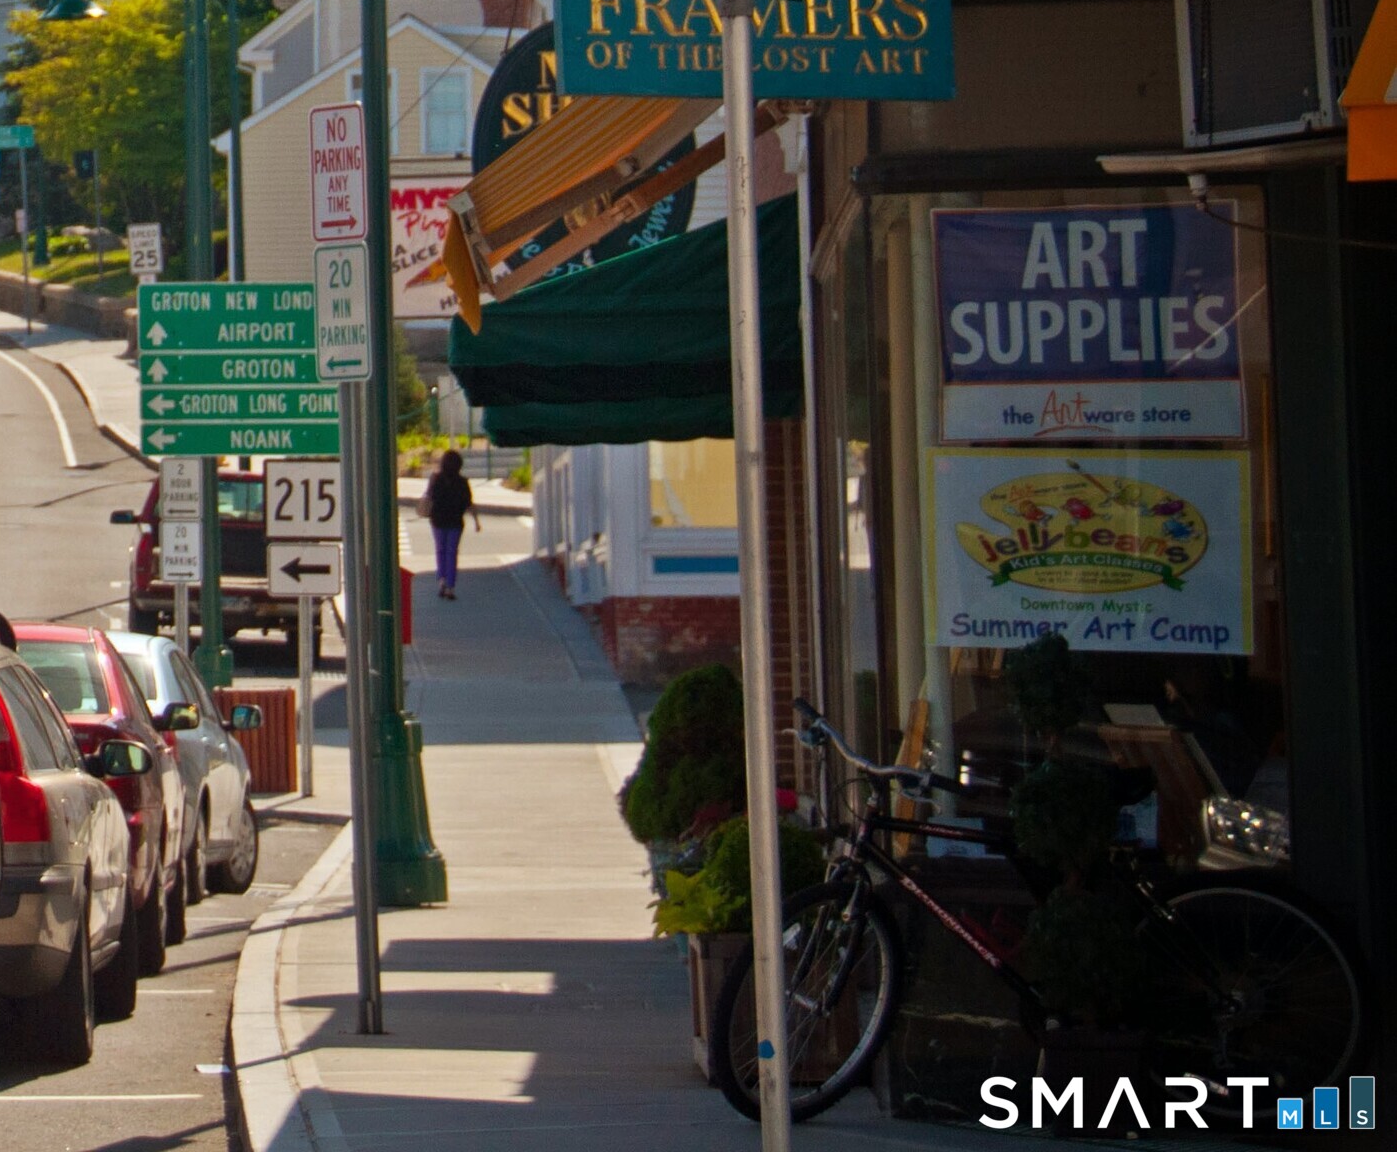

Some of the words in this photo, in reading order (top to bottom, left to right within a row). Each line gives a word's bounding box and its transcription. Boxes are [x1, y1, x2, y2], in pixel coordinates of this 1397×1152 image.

[586, 41, 632, 69] OF
[751, 44, 835, 72] OST
[856, 47, 928, 74] ART
[326, 117, 347, 142] NO
[314, 146, 361, 173] PARKING
[328, 174, 348, 193] ANY
[327, 196, 350, 212] TIME
[133, 250, 158, 268] 25
[1022, 219, 1147, 289] ART
[329, 259, 352, 288] 20
[152, 291, 211, 311] GROTON
[225, 292, 258, 310] NEW
[273, 291, 313, 310] LOND
[332, 300, 351, 318] MIN
[217, 322, 295, 342] AIRPORT
[320, 323, 365, 346] PARKING
[950, 296, 1229, 365] SUPPLIES
[222, 359, 296, 379] GROTON
[181, 394, 238, 414] GROTON
[249, 393, 287, 413] LONG
[1003, 406, 1034, 425] the
[1142, 406, 1191, 423] store
[230, 429, 293, 449] NOANK
[274, 477, 335, 522] 215
[978, 523, 1190, 564] jellybeans
[1009, 554, 1055, 571] Kid's
[1059, 554, 1089, 565] Art
[1093, 555, 1165, 574] Classes
[1020, 597, 1094, 612] Downtown
[1102, 598, 1153, 613] Mystic
[950, 613, 1068, 640] Summer
[1083, 615, 1136, 641] Art
[1149, 617, 1230, 649] Camp
